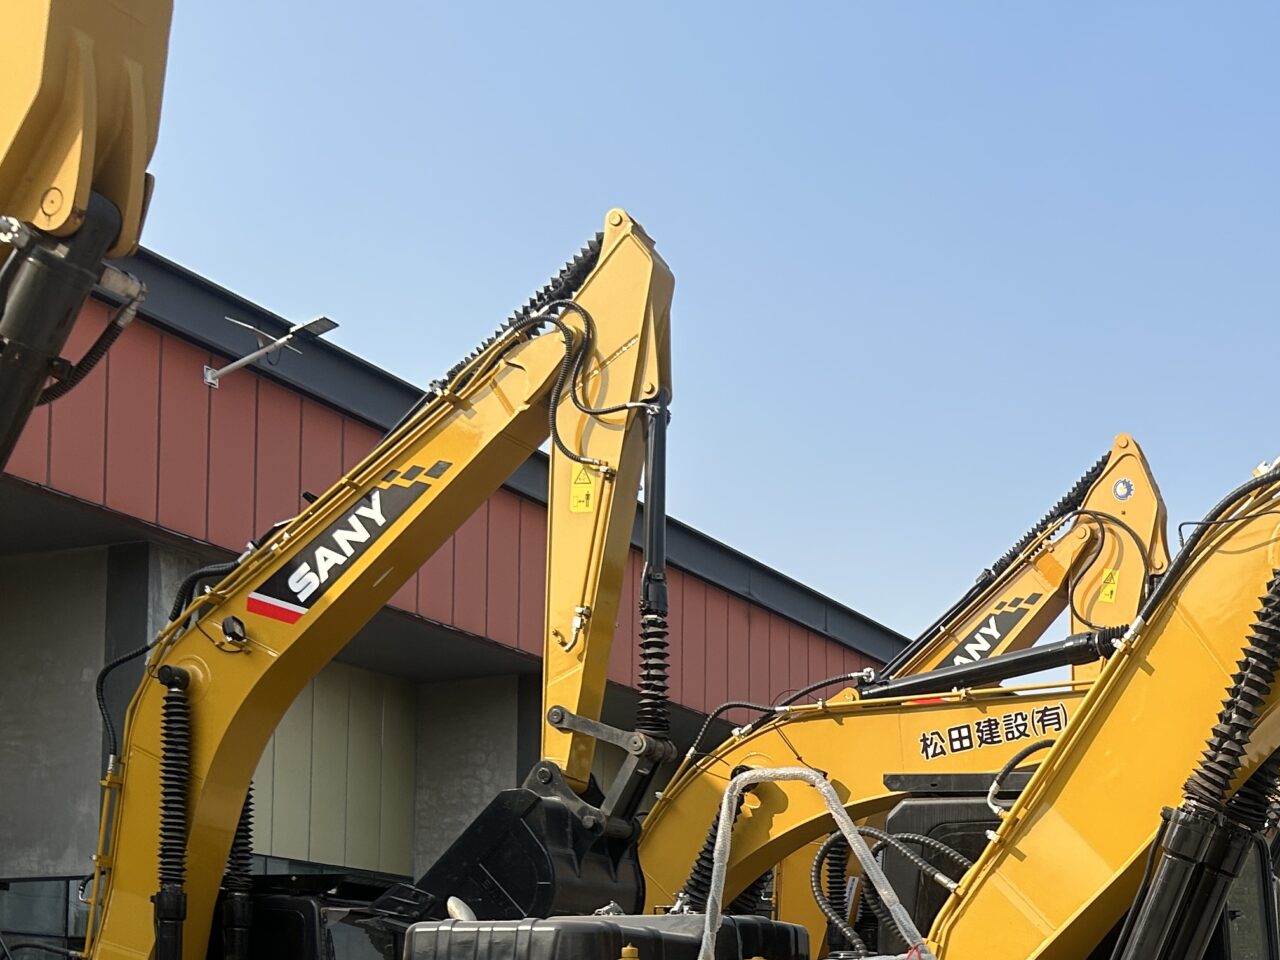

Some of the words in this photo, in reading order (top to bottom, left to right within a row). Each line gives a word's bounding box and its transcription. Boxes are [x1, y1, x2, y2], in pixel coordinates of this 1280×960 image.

[287, 489, 387, 603] SANY
[920, 702, 1068, 760] 松田建設(有)
